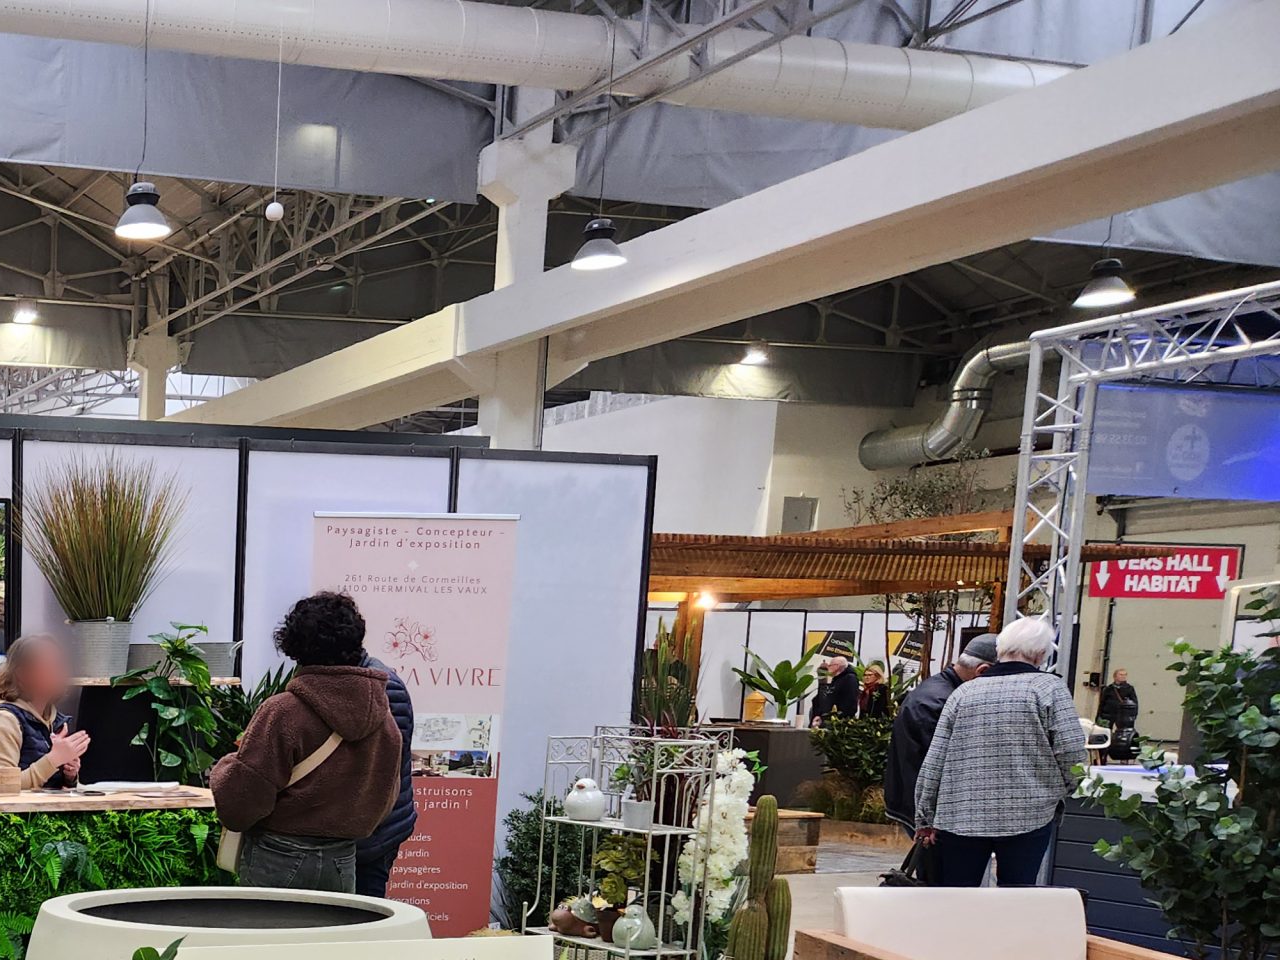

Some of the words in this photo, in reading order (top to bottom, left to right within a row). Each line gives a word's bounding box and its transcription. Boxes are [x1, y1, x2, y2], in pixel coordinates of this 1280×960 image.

[327, 525, 397, 537] Paysagiste
[417, 527, 493, 539] Concepteur
[349, 538, 389, 548] Jardin
[396, 539, 480, 550] d'exposition
[1118, 558, 1164, 571] VERS
[1166, 554, 1213, 572] HALL
[345, 574, 363, 583] 261
[368, 575, 398, 583] Route
[404, 575, 416, 584] de
[421, 576, 481, 584] Cormeilles
[1124, 574, 1202, 593] HABITAT
[373, 585, 428, 593] HERMIVAL
[434, 586, 453, 594] LES
[458, 586, 487, 594] VAUX
[429, 667, 501, 686] VIVRE
[413, 787, 473, 796] struisons
[424, 799, 460, 811] jardin
[404, 849, 430, 858] jardin
[392, 864, 441, 876] paysagères
[390, 880, 414, 890] jardin
[416, 880, 469, 892] d'exposition
